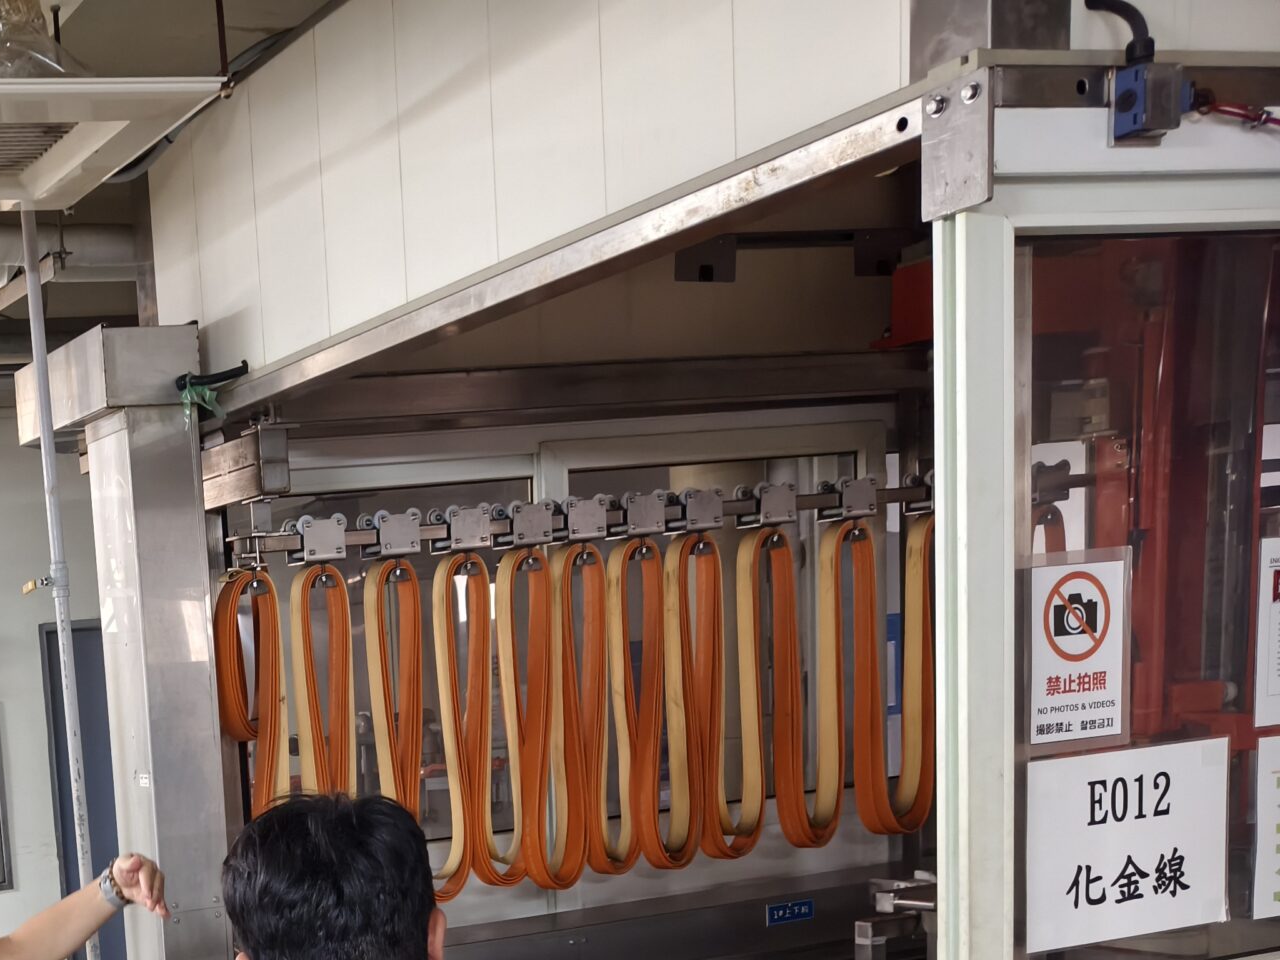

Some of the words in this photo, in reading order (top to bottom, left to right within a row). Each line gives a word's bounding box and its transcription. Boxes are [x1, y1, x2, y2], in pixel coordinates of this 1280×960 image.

[1046, 671, 1107, 696] 禁止拍照
[1037, 707, 1048, 716] NO
[1050, 703, 1079, 714] PHOTOS
[1081, 702, 1086, 711] &
[1089, 700, 1115, 710] VIDEOS
[1036, 721, 1073, 736] 撮影禁止
[1080, 718, 1114, 731] 촬영금지
[1087, 771, 1171, 826] E012
[1065, 847, 1191, 909] 化金線
